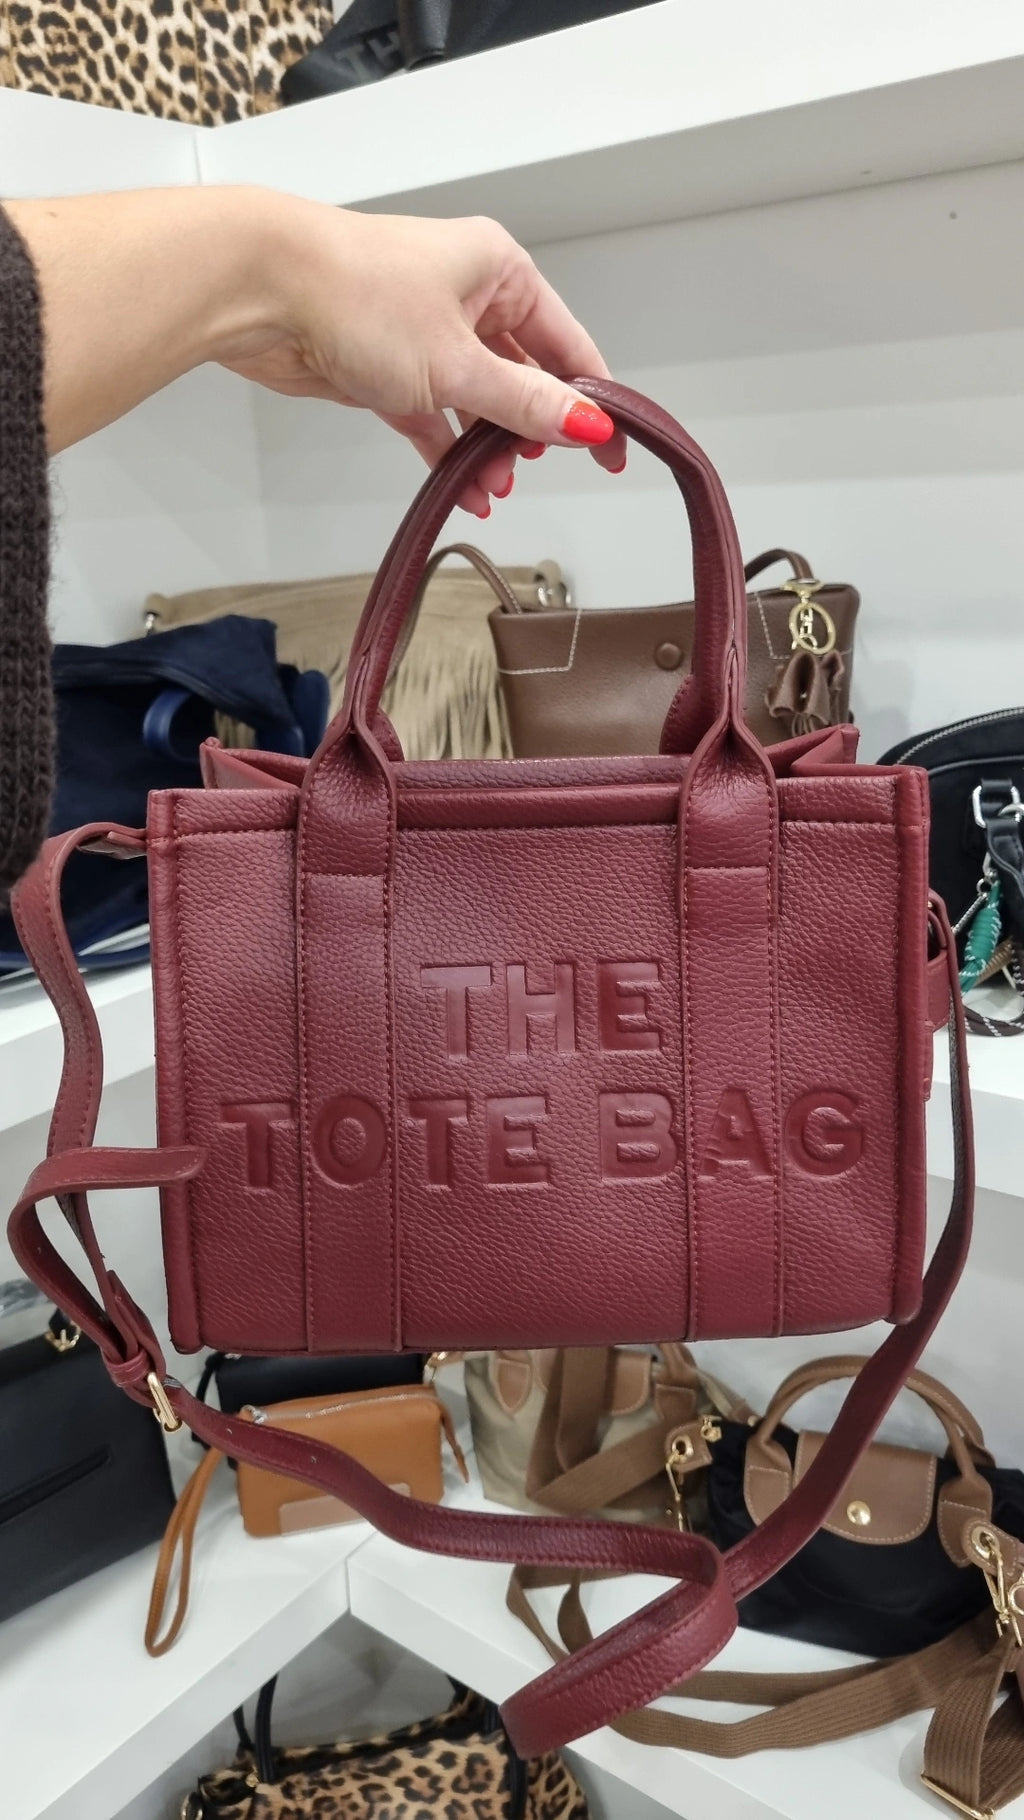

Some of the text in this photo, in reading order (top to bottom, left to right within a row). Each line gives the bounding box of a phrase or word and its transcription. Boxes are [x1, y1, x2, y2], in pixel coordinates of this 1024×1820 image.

[420, 961, 662, 1060] THE
[220, 1086, 866, 1191] TOTE BAG
